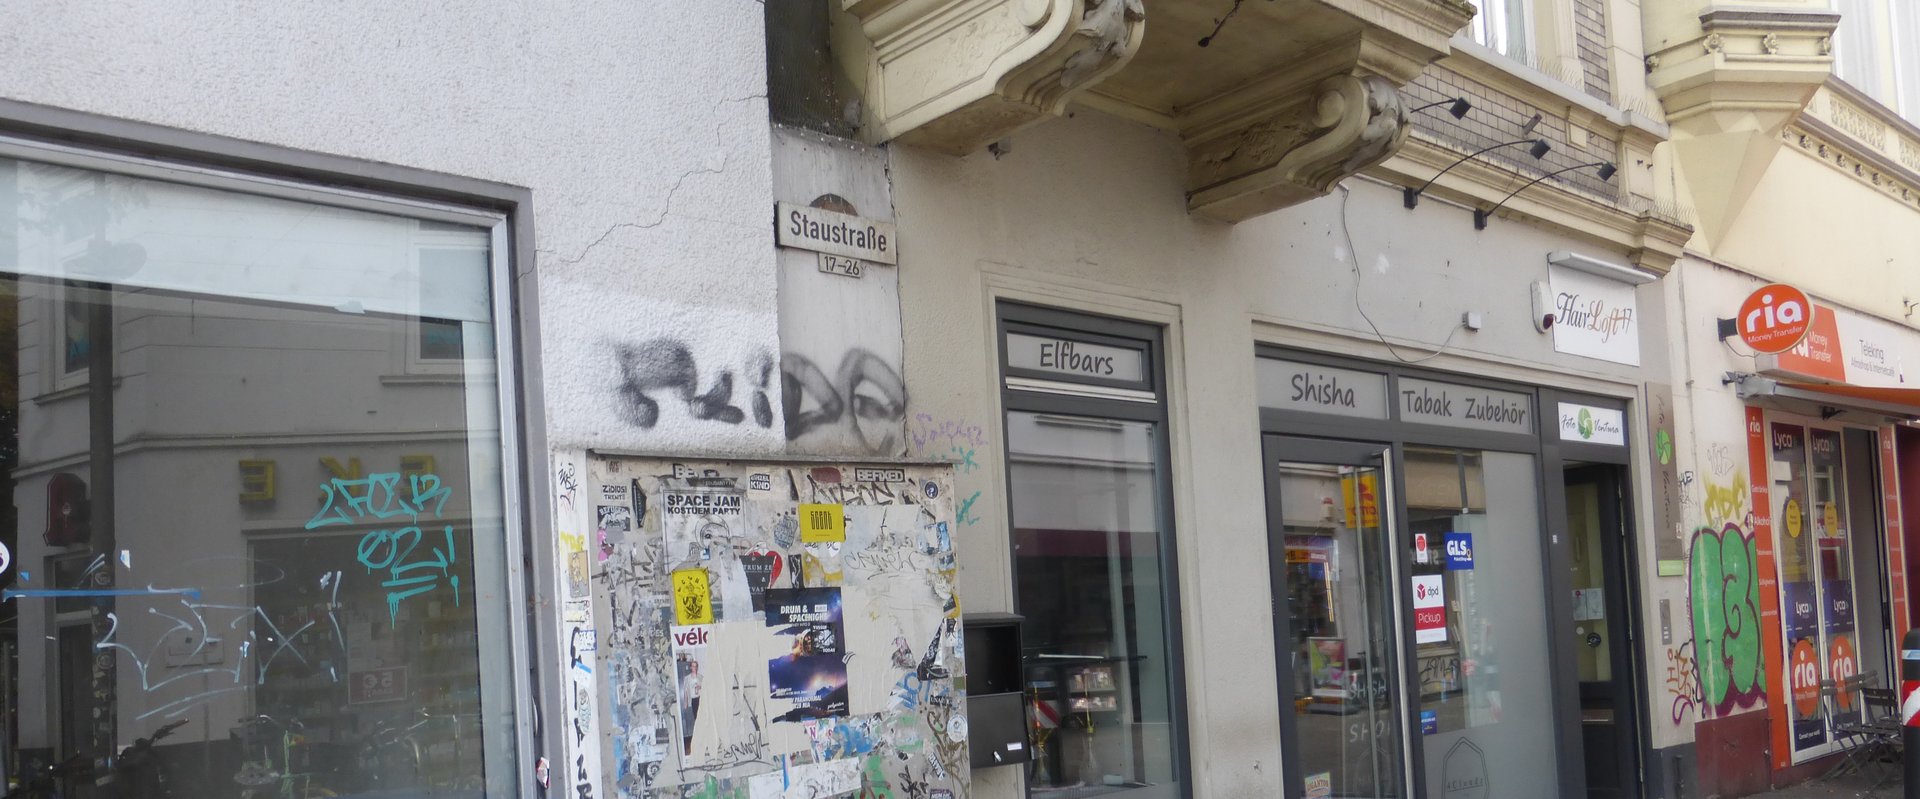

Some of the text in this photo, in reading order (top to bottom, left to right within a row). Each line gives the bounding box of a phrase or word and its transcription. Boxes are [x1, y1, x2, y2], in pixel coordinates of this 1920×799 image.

[790, 210, 887, 252] Staustraße
[1746, 294, 1803, 333] ria
[1747, 325, 1803, 343] Money Transfer
[1809, 331, 1828, 351] Money
[1040, 341, 1114, 375] Elfbars
[1810, 346, 1832, 363] Transfer
[1291, 373, 1356, 408] Shisha
[1403, 388, 1526, 425] Tabak Zubehör
[1750, 416, 1761, 433] ria
[1774, 430, 1793, 450] Lyca
[857, 469, 903, 481] BEFIXED
[750, 481, 770, 490] KIND
[667, 495, 741, 507] SPACE JAM
[667, 506, 741, 515] KOSTUEM PARTY
[1446, 540, 1467, 556] GLS
[1427, 586, 1439, 597] dpd
[780, 605, 801, 614] DRUM
[802, 604, 808, 613] &
[1795, 601, 1809, 616] Lyca
[1833, 599, 1846, 613] Lyca
[1418, 613, 1441, 624] Pickup
[1794, 650, 1816, 689] ria
[1832, 646, 1853, 682] ria
